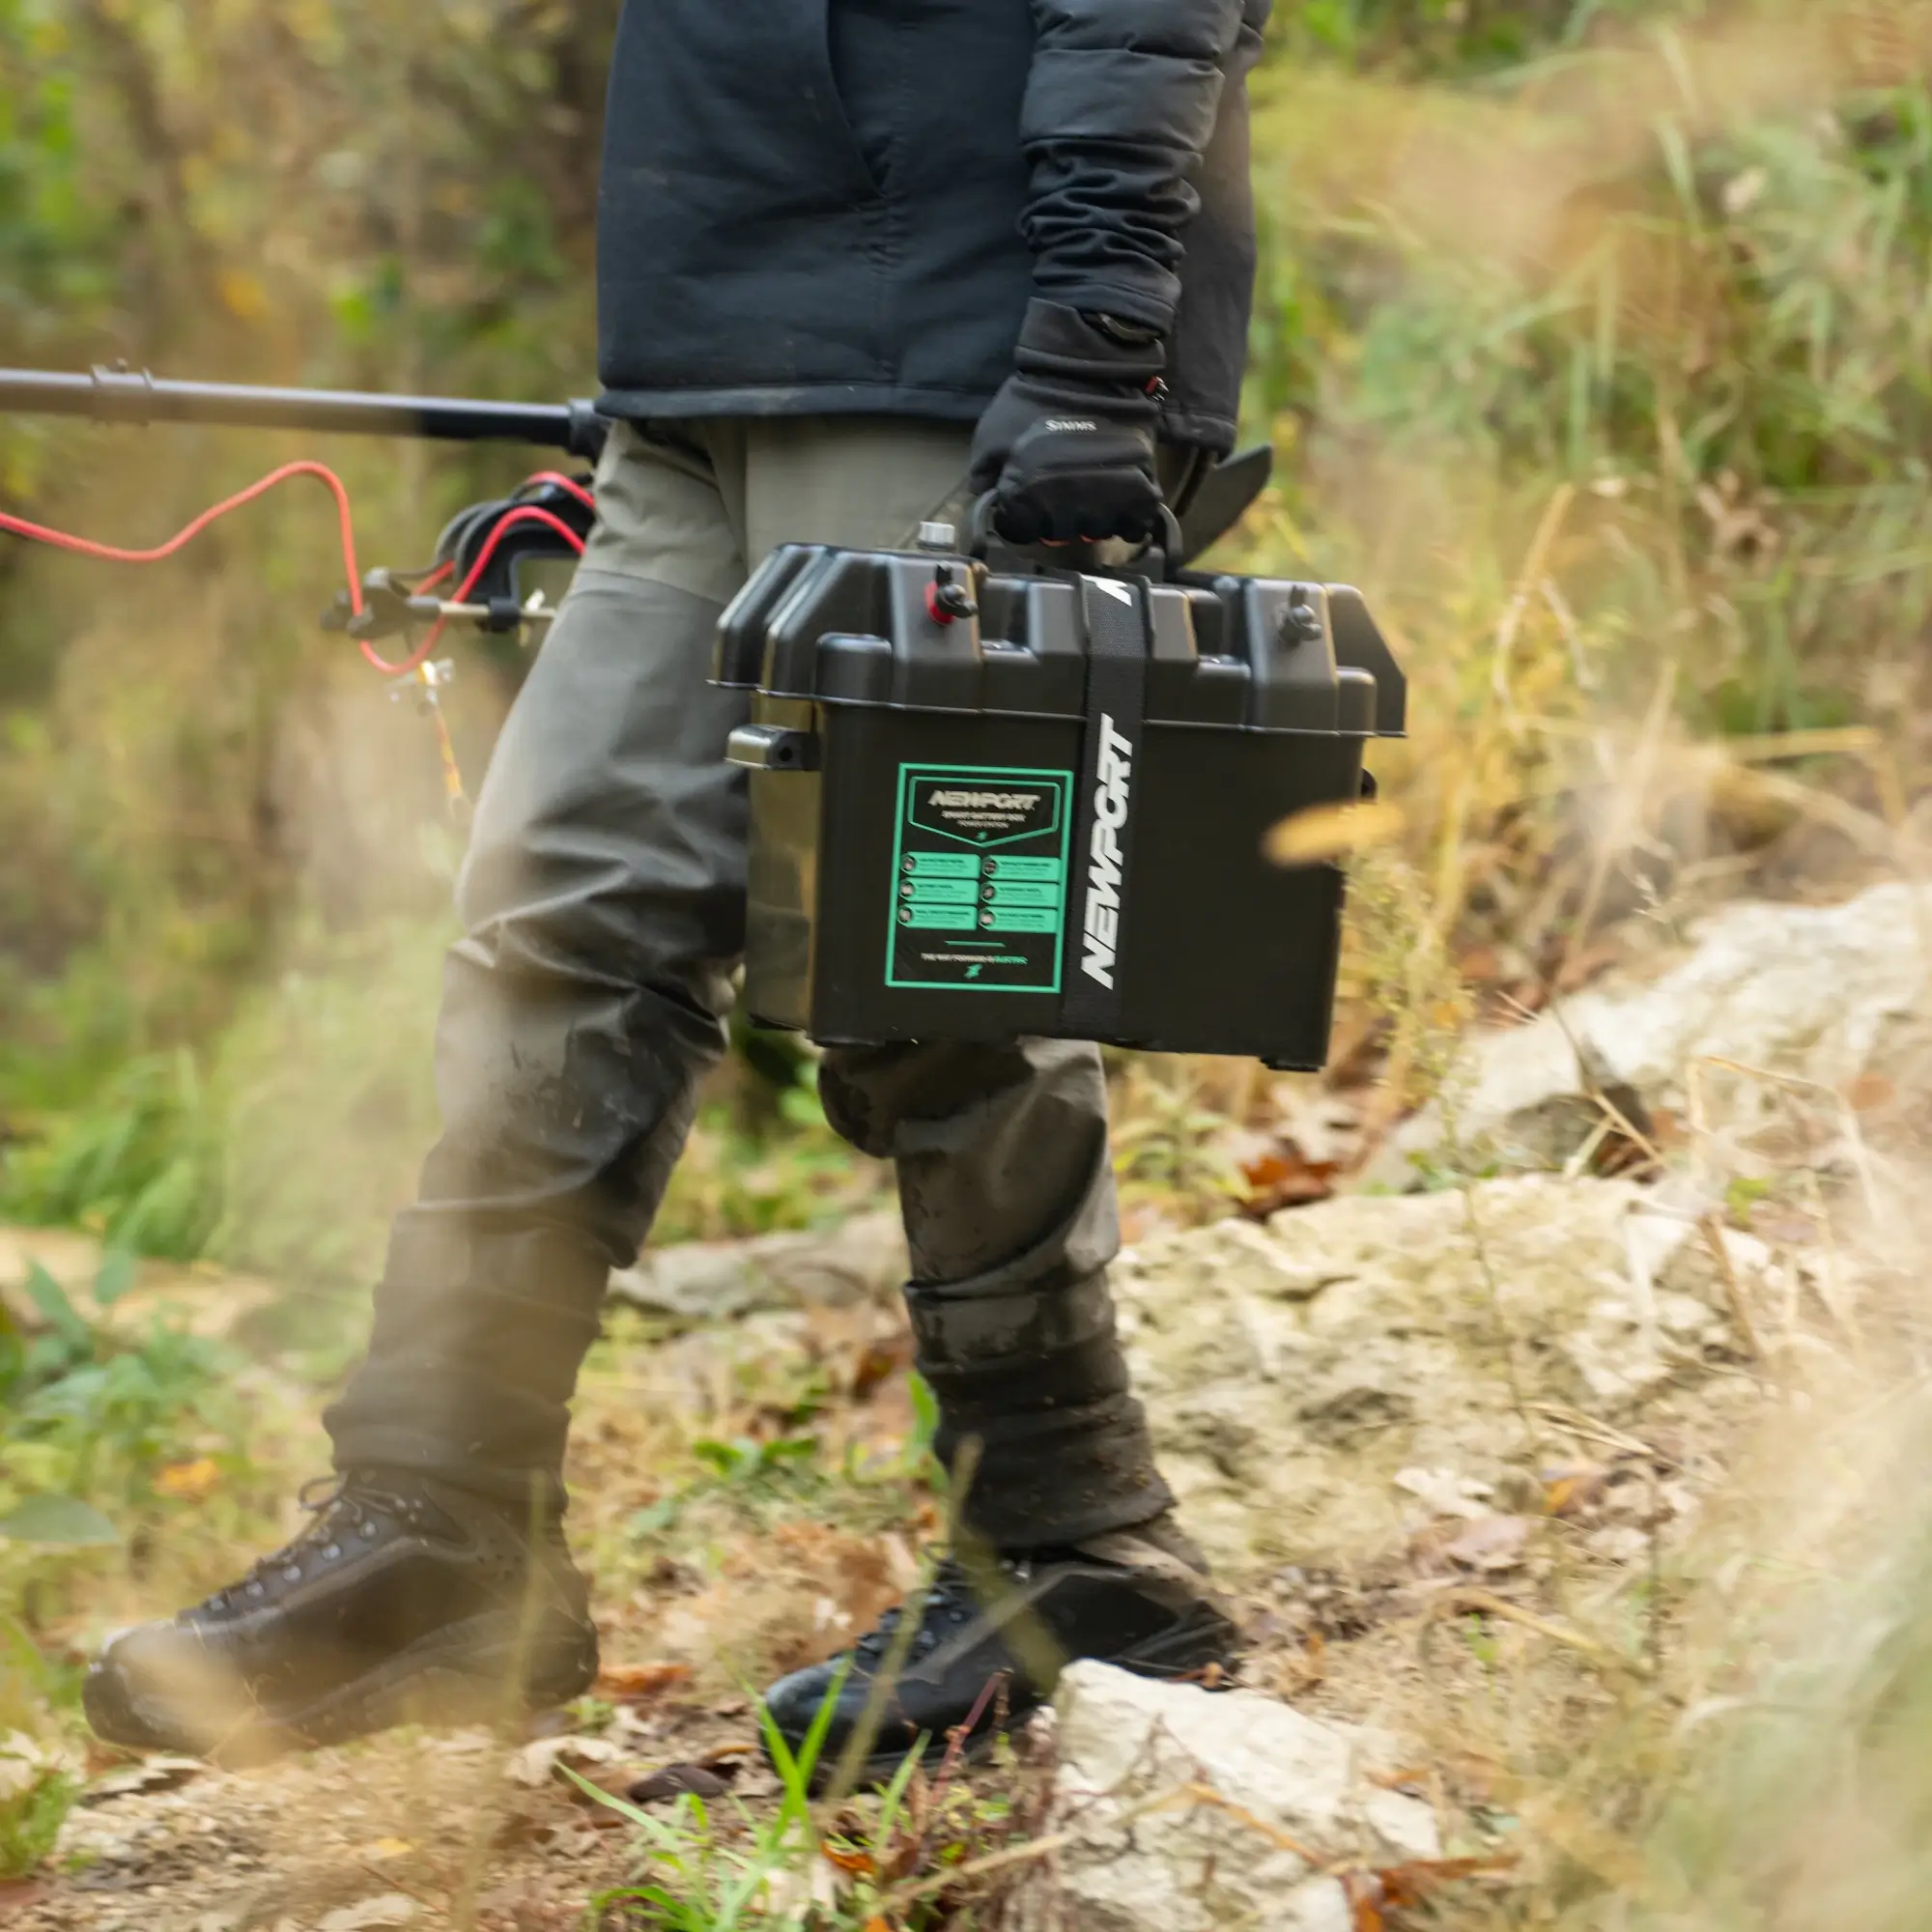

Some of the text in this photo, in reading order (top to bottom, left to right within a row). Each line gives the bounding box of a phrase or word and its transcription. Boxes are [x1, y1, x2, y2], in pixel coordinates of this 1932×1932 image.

[1045, 418, 1098, 433] SIMMS
[927, 789, 1041, 810] NEWPORT
[1081, 712, 1133, 991] NEWPORT
